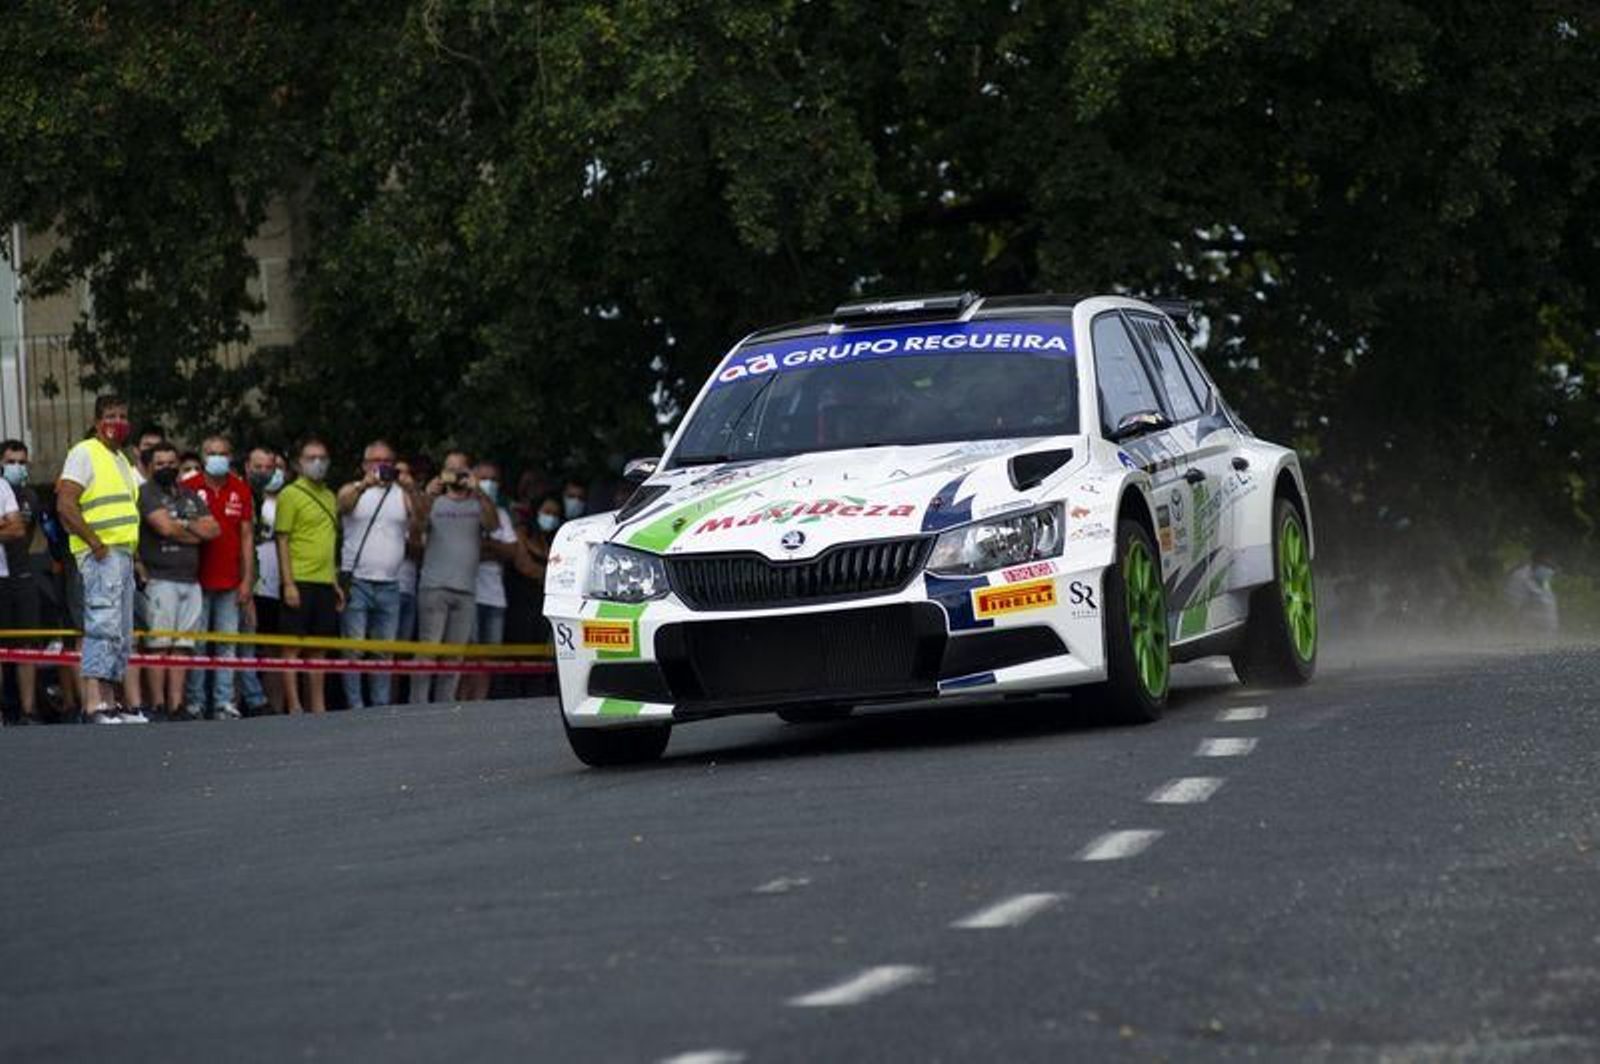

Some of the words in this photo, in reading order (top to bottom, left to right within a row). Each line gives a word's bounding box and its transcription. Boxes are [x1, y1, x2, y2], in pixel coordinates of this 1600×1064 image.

[783, 338, 898, 367] GRUPO
[903, 333, 1068, 351] REGUEIRA
[979, 584, 1054, 612] PIRELLI
[583, 627, 630, 644] PIRELLI
